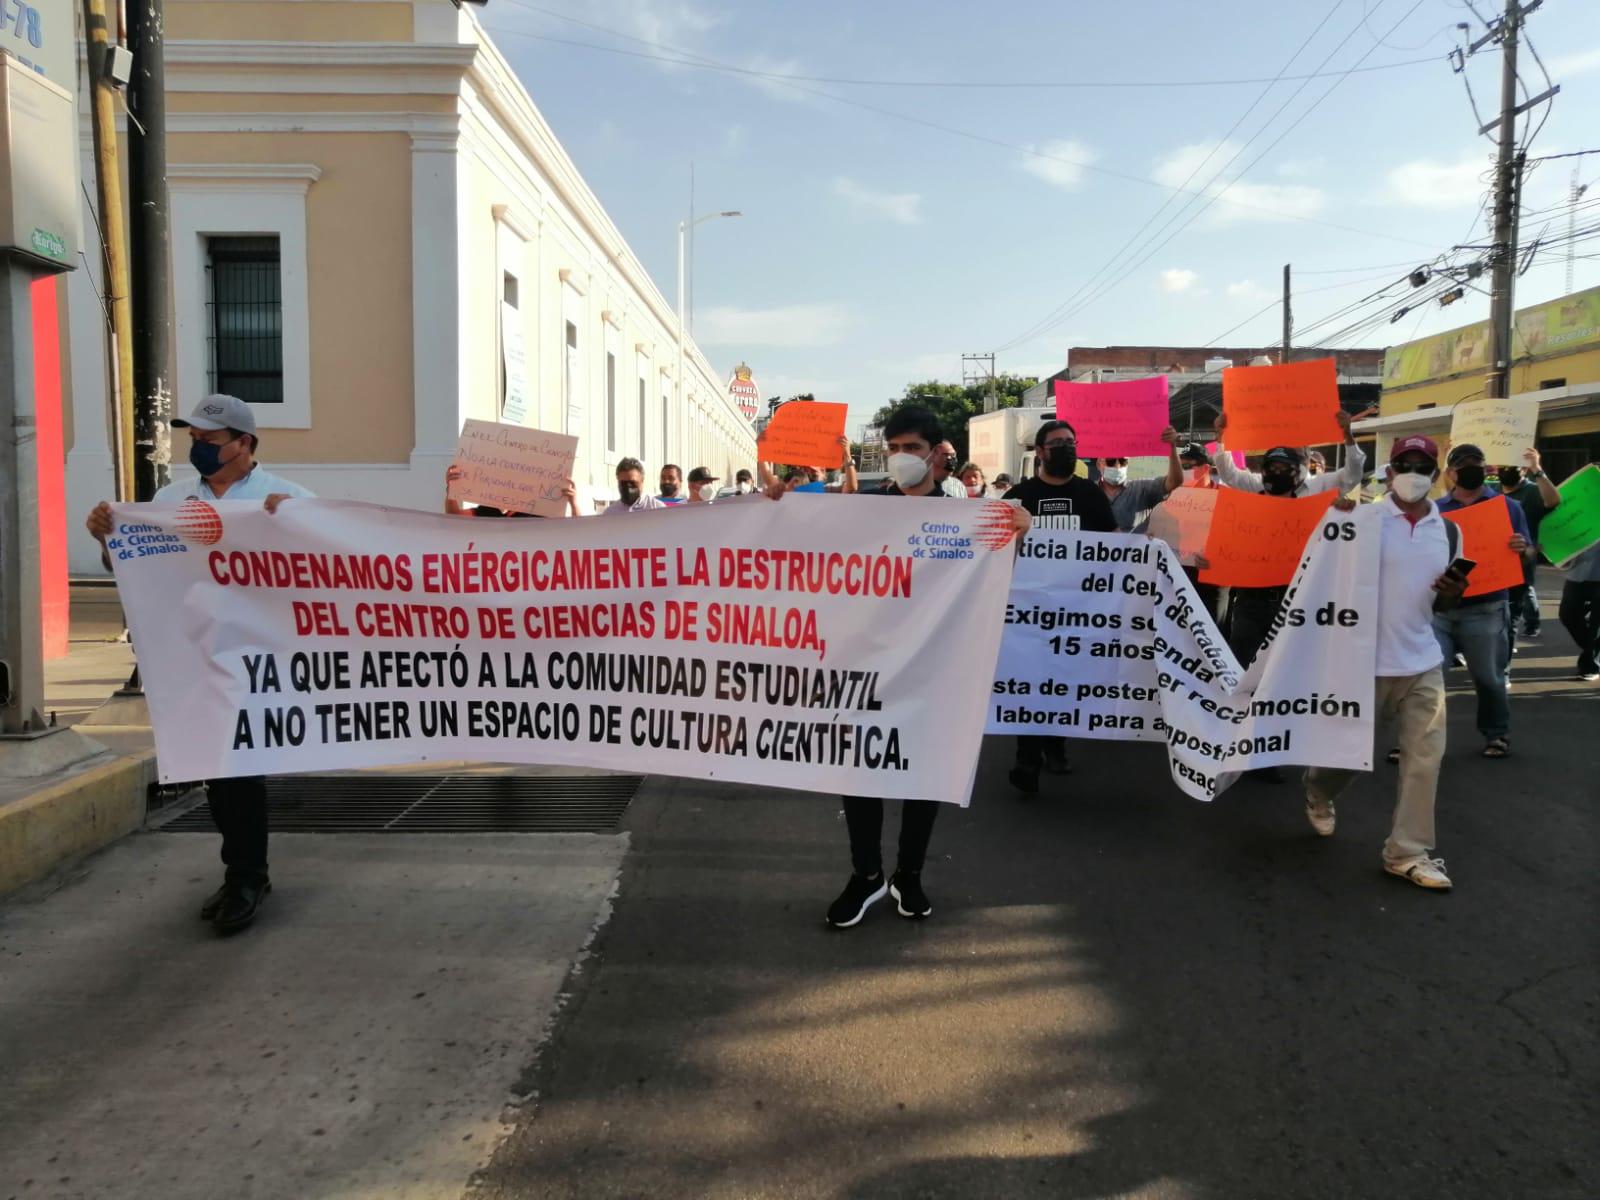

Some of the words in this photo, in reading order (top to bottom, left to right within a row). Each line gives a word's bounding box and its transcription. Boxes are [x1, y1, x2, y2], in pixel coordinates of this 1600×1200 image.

[108, 538, 125, 550] de
[127, 531, 180, 547] Ciencias
[119, 523, 162, 536] Centro
[921, 521, 960, 535] Centro
[118, 548, 135, 561] de
[137, 543, 188, 558] Sinaloa
[907, 535, 921, 546] de
[924, 534, 972, 549] Ciencias
[912, 547, 927, 560] de
[929, 547, 974, 560] Sinaloa
[1076, 539, 1150, 564] laboral
[208, 550, 413, 593] CONDENAMOS
[423, 542, 667, 593] ENÉRGICAMENTE
[675, 547, 711, 586] LA
[718, 544, 913, 599] DESTRUCCIÓN
[1081, 573, 1114, 593] del
[1004, 603, 1123, 631] Exigimos
[1315, 602, 1360, 627] de
[292, 600, 350, 636] DEL
[355, 602, 470, 639] CENTRO
[477, 606, 516, 639] DE
[523, 600, 655, 640] CIENCIAS
[663, 600, 698, 641] DE
[705, 602, 827, 662] SINALOA,
[1049, 635, 1080, 656] 15
[1090, 635, 1155, 660] años
[242, 653, 282, 694] YA
[289, 650, 351, 696] QUE
[360, 643, 470, 690] AFECTÓ
[477, 651, 497, 689] A
[504, 651, 540, 689] LA
[547, 650, 707, 699] COMUNIDAD
[715, 660, 884, 712] ESTUDIANTIL
[1039, 677, 1068, 696] de
[996, 705, 1080, 726] laboral
[1088, 710, 1145, 732] para
[233, 708, 255, 751] A
[264, 704, 306, 748] NO
[315, 702, 411, 744] TENER
[419, 700, 459, 738] UN
[468, 699, 580, 741] ESPACIO
[588, 703, 621, 745] DE
[629, 706, 748, 757] CULTURA
[755, 713, 910, 772] CIENTÍFICA.
